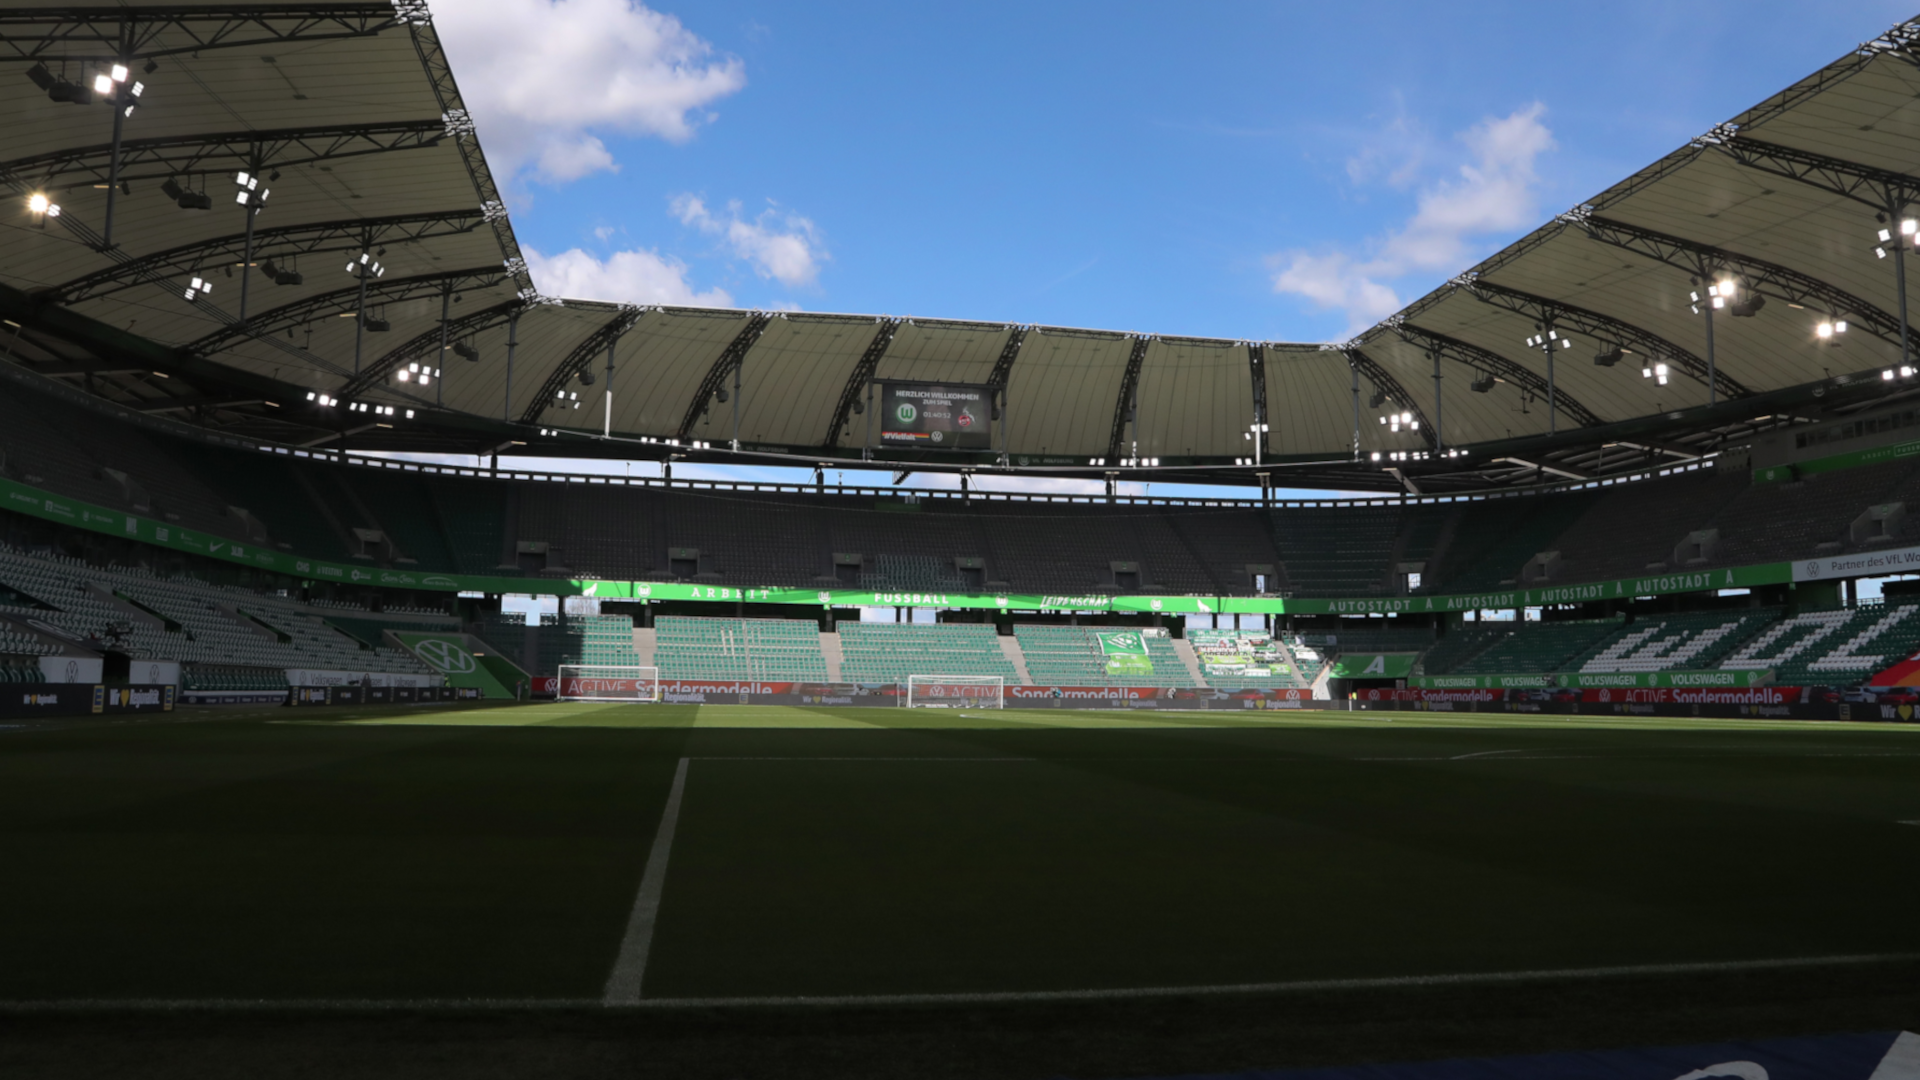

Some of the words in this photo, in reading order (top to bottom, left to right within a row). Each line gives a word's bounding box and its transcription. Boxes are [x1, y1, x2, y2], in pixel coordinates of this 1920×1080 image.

[896, 390, 930, 398] HERZLICH
[931, 391, 979, 401] WILLKOMMEN
[884, 432, 916, 441] #Vielfalt
[296, 560, 310, 573] CHG
[1832, 560, 1866, 571] Partner
[1868, 557, 1884, 567] des
[1886, 554, 1903, 565] VfL
[322, 566, 343, 577] VELTINS
[1635, 573, 1711, 593] AUTOSTADT
[691, 587, 770, 600] ARBEIT
[874, 592, 949, 604] FUSSBALL
[1541, 584, 1604, 602] AUTOSTADT
[1040, 596, 1117, 608] LEIDENSCHAFT
[1328, 600, 1411, 612] AUTOSTADT
[1447, 594, 1514, 609] AUTOSTADT
[310, 673, 342, 686] Volkswagen
[1433, 678, 1477, 687] VOLKSWAGEN
[1579, 675, 1637, 686] VOLKSWAGEN
[1670, 674, 1735, 685] VOLKSWAGEN
[568, 680, 627, 696] ACTIVE
[635, 680, 773, 695] Sondermodelle
[1391, 690, 1419, 701] ACTIVE
[1421, 689, 1494, 702] Sondermodelle
[1626, 689, 1668, 703] ACTIVE
[1672, 688, 1783, 704] Sondermodelle
[1244, 700, 1255, 709] Wir
[1266, 700, 1302, 711] Regionalität.
[1880, 704, 1896, 719] Wir
